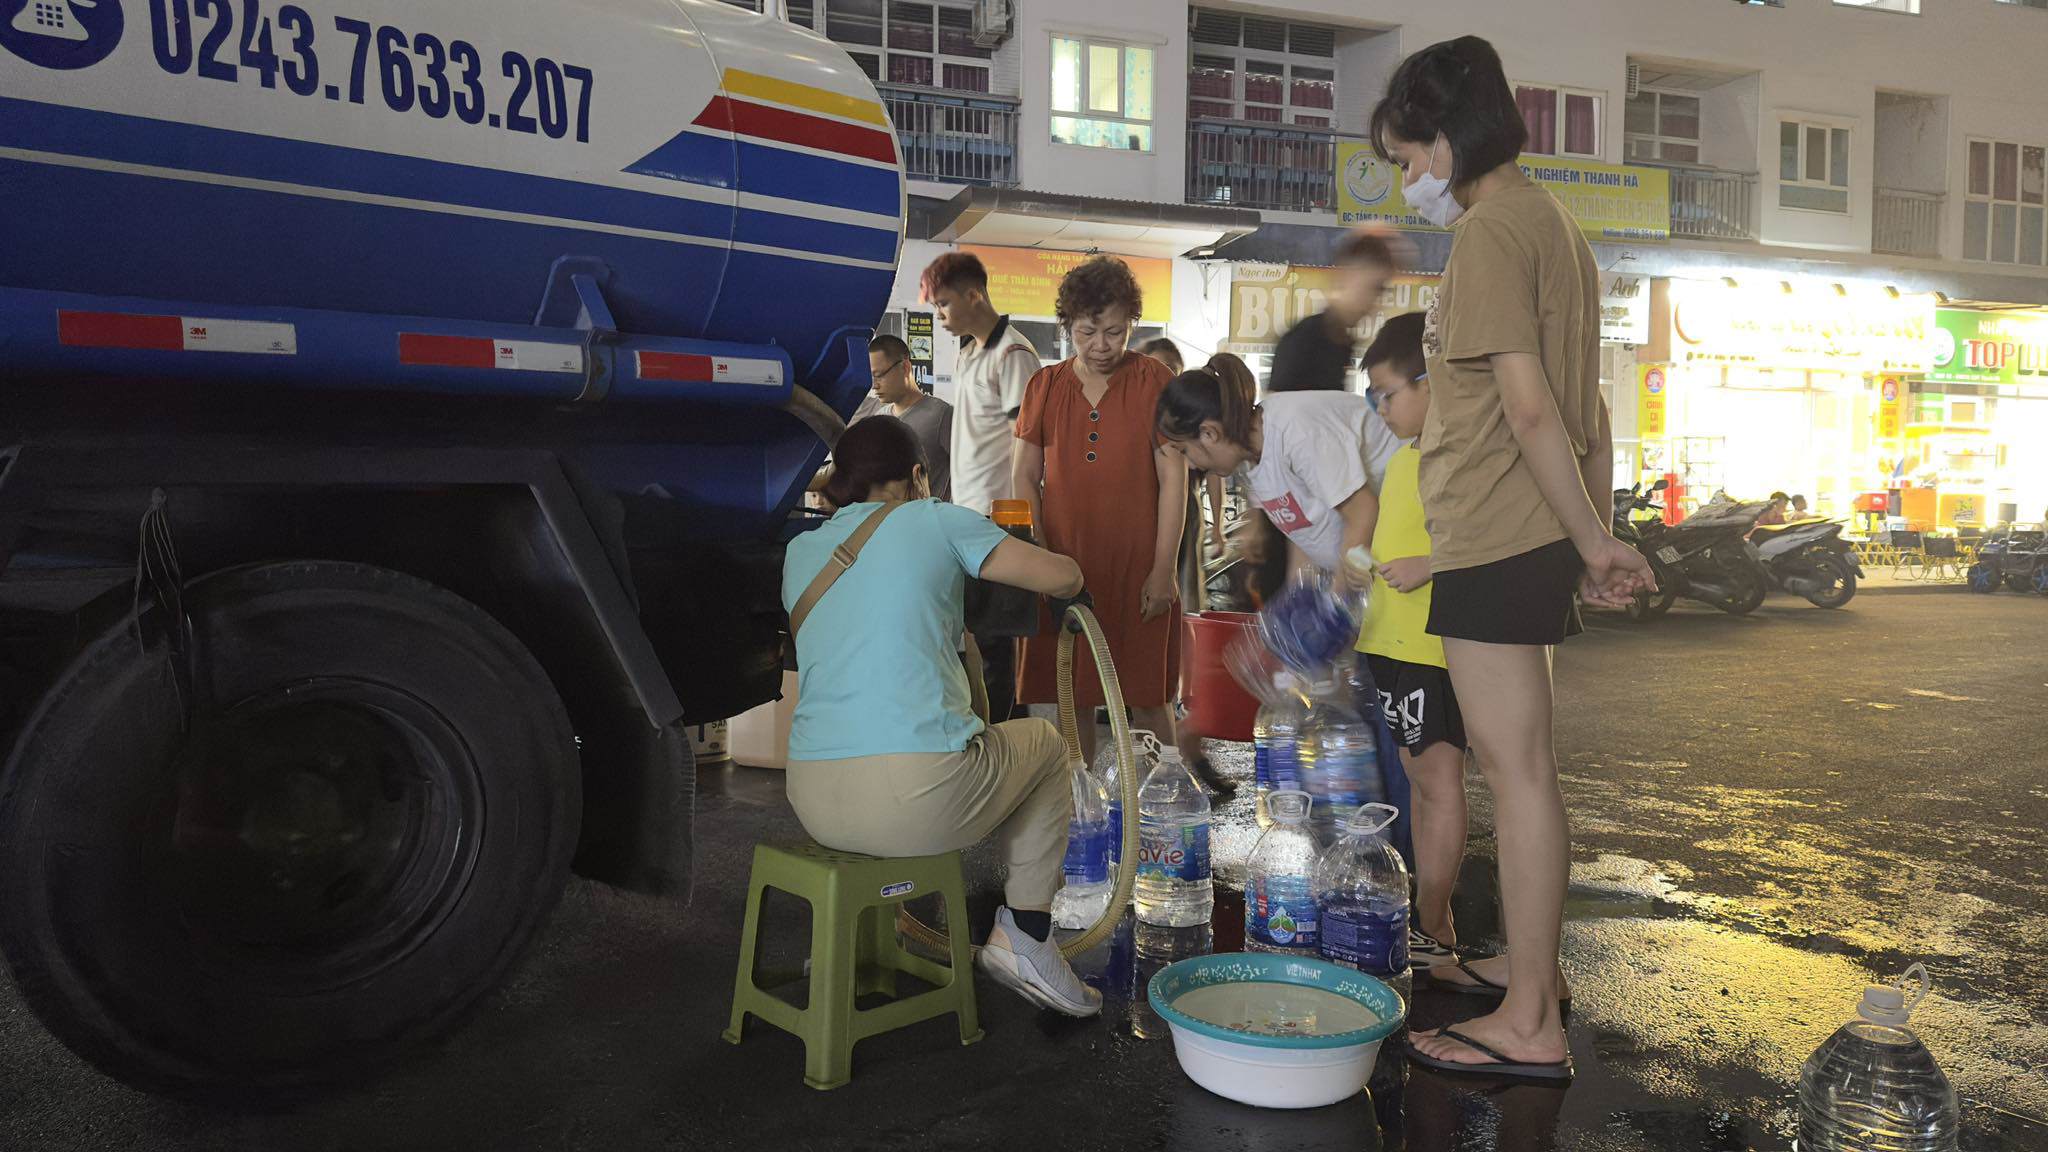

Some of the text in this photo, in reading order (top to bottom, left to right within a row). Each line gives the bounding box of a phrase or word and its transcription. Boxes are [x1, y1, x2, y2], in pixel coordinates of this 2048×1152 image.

[149, 0, 593, 143] 0243.7633.207
[1534, 167, 1580, 185] NGHIỆM
[1584, 171, 1620, 186] THANH
[190, 327, 207, 336] 3M
[500, 347, 513, 355] 3M
[1966, 339, 2015, 368] TOP
